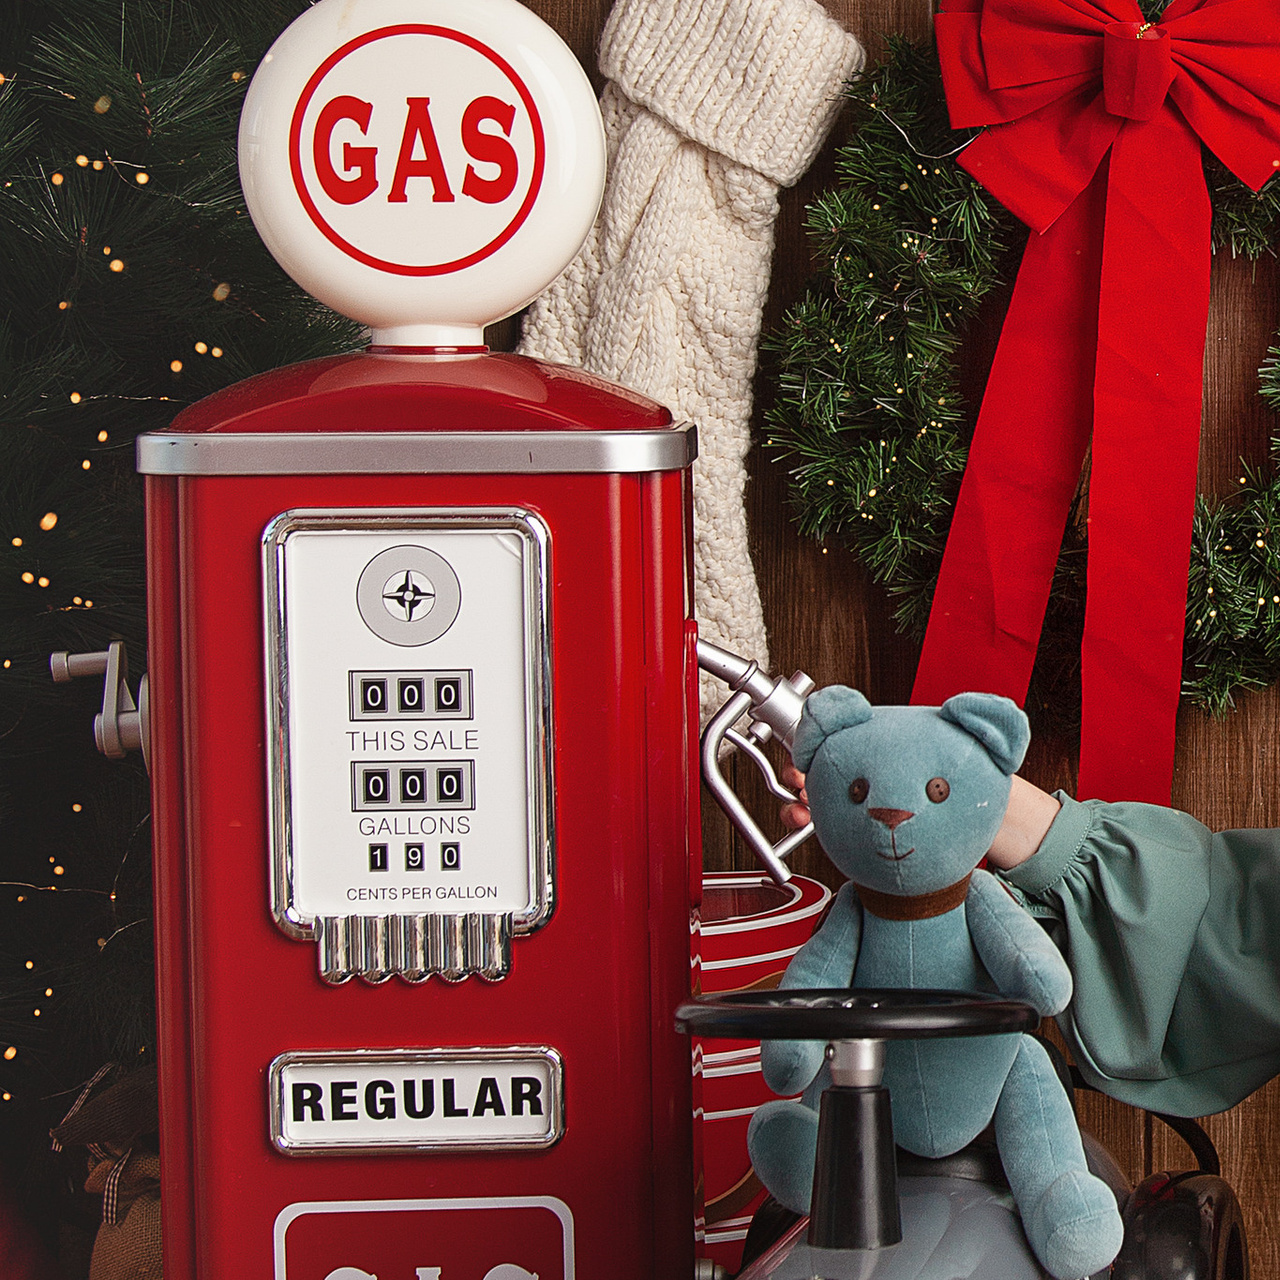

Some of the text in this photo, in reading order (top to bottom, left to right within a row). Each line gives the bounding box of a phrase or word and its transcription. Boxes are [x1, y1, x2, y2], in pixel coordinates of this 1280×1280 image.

[313, 95, 519, 205] GAS
[345, 730, 480, 751] THIS SALE
[359, 816, 472, 836] GALLONS
[346, 885, 498, 901] CENTS PER GALLON
[292, 1076, 544, 1122] REGULAR
